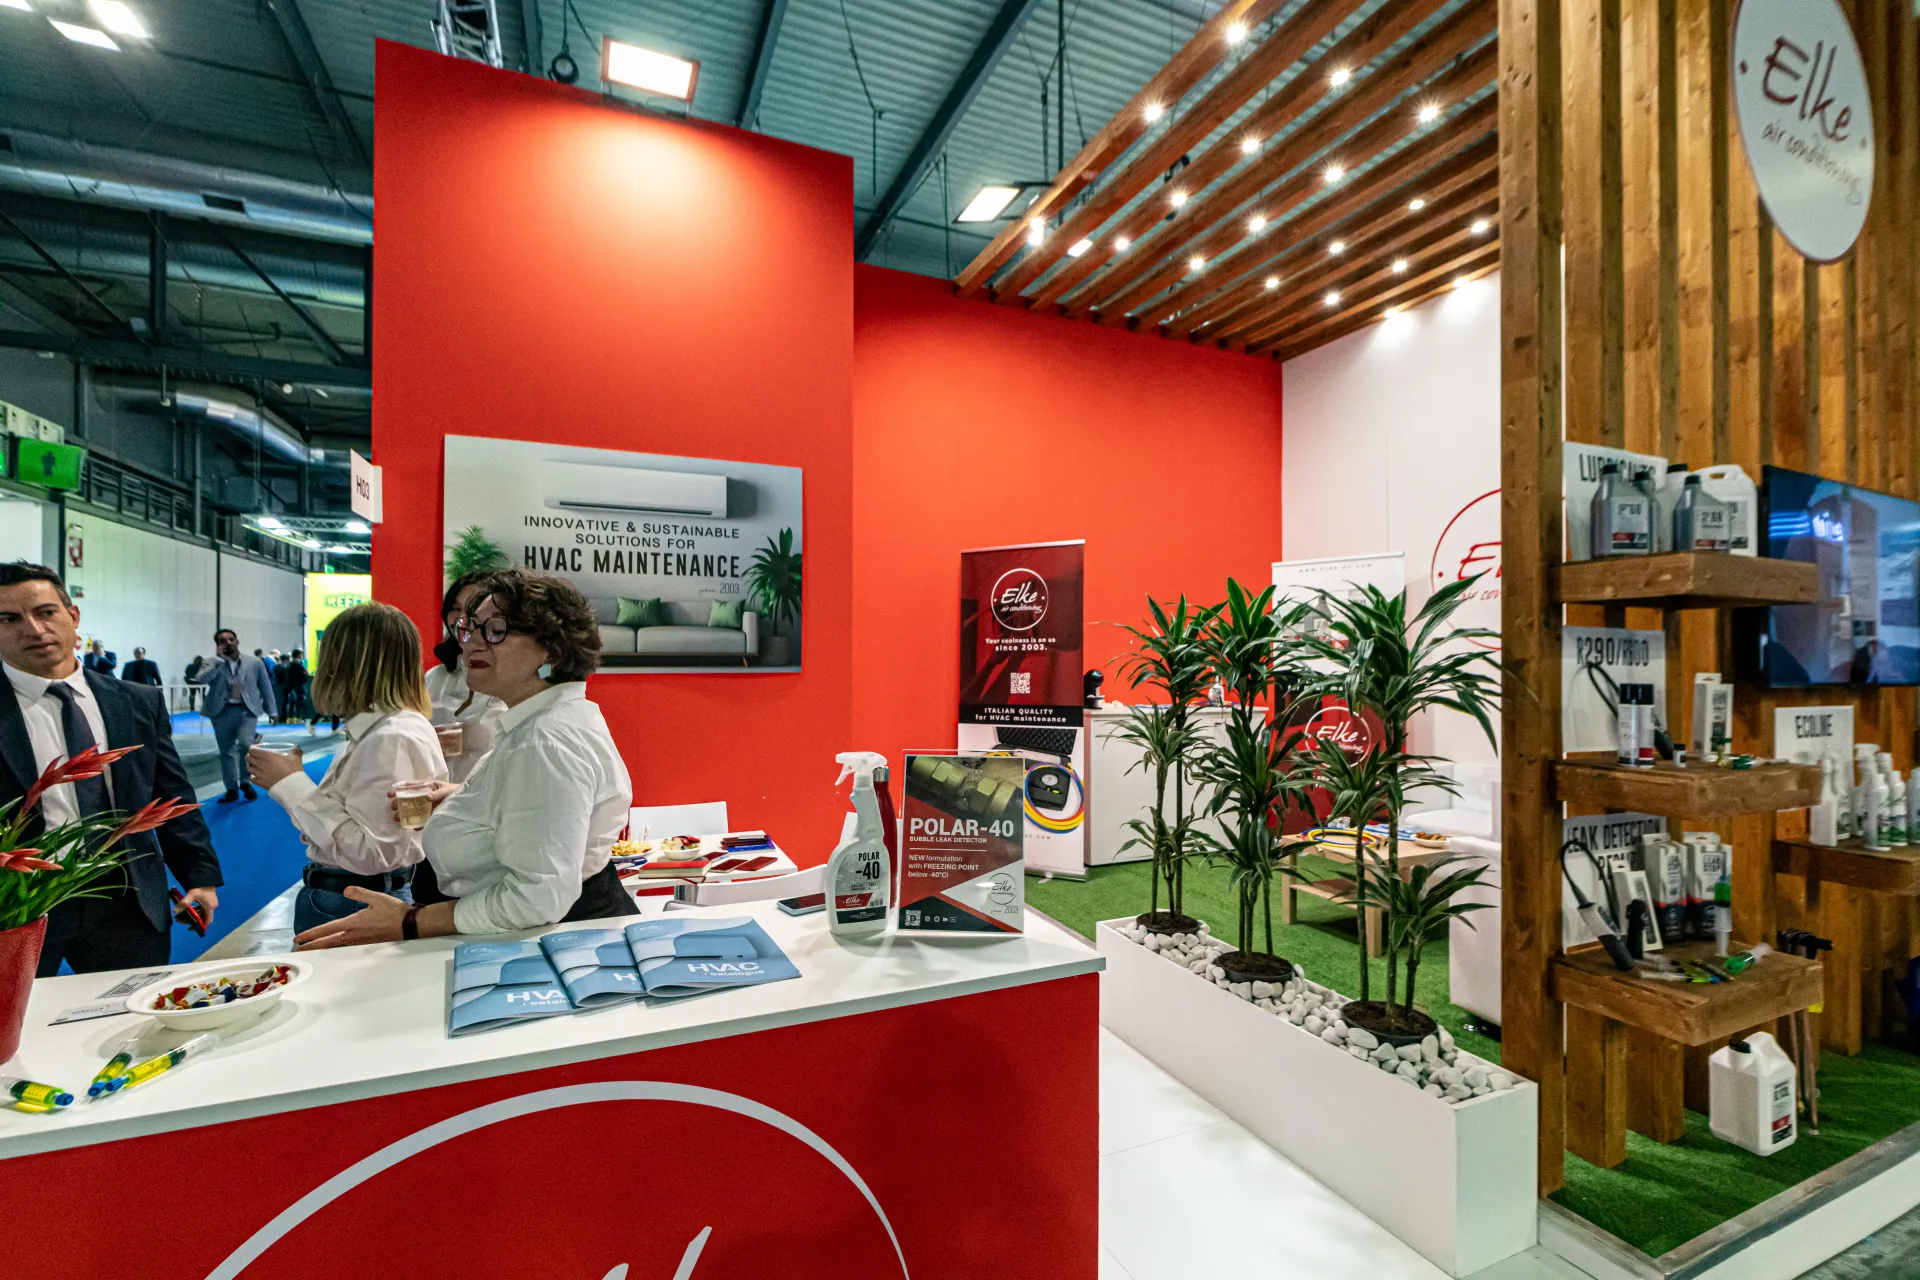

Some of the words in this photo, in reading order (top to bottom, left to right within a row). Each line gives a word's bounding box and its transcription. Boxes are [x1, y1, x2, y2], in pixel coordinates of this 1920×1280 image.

[1762, 36, 1852, 142] Elke
[356, 474, 370, 500] H03
[524, 516, 620, 532] INNOVATIVE
[626, 522, 636, 532] &
[643, 523, 740, 538] SUSTAINABLE
[576, 534, 660, 548] SOLUTIONS
[668, 538, 696, 550] FOR
[524, 546, 582, 572] HVAC
[593, 549, 740, 578] MAINTENANCE
[720, 582, 740, 594] 2003
[1001, 581, 1038, 604] Elke
[1317, 721, 1358, 742] Elke
[910, 818, 1014, 837] POLAR-40
[859, 852, 879, 861] POLAR
[856, 861, 880, 880] -40
[992, 880, 1012, 891] Elke
[687, 962, 760, 972] HVAC
